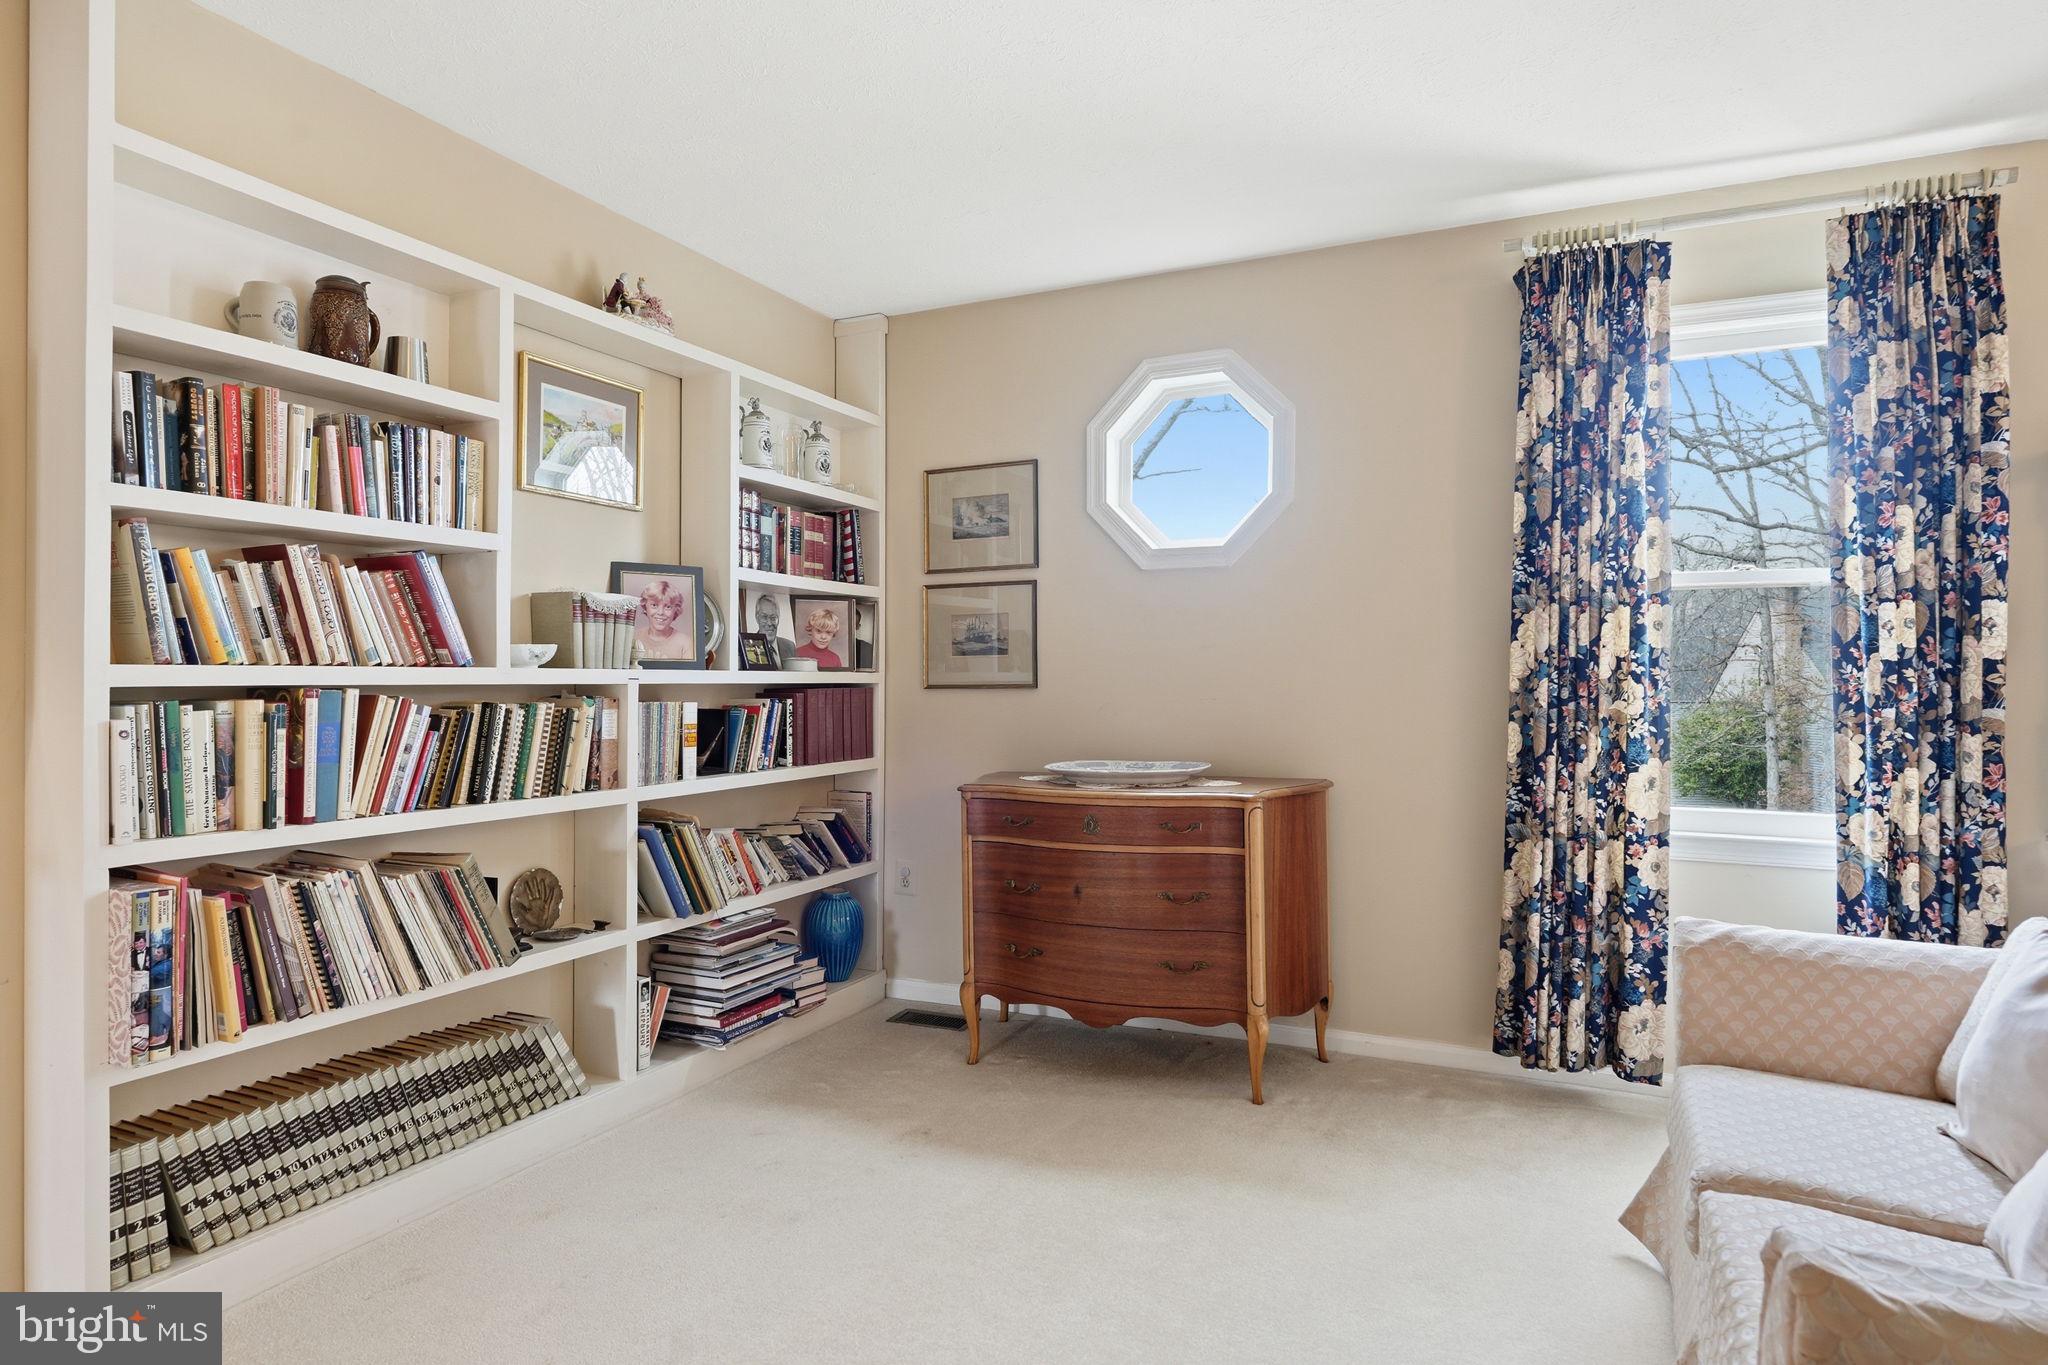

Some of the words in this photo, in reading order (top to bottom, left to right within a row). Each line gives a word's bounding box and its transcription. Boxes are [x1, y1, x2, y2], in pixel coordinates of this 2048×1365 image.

[140, 548, 156, 584] ZANE
[145, 580, 162, 619] GREY
[182, 727, 191, 751] BOOK
[144, 728, 153, 772] CROCKERY
[184, 755, 193, 794] SAUSAGE
[119, 764, 128, 805] CHOCOLATE
[147, 775, 155, 814] COOKING
[185, 799, 194, 818] THE
[430, 1109, 441, 1120] 20
[444, 1106, 455, 1117] 21
[404, 1120, 414, 1130] 18
[418, 1114, 428, 1125] 19
[391, 1124, 400, 1135] 17
[363, 1135, 374, 1146] 15
[377, 1130, 387, 1141] 16
[348, 1140, 359, 1152] 14
[319, 1151, 331, 1163] 12
[334, 1146, 345, 1158] 13
[288, 1161, 300, 1175] 10
[306, 1157, 315, 1168] 11
[274, 1169, 282, 1178] 9
[258, 1175, 266, 1184] 8
[241, 1181, 248, 1191] 7
[224, 1187, 232, 1197] 6
[206, 1194, 214, 1204] 5
[187, 1202, 196, 1212] 4
[153, 1213, 162, 1225] 3
[134, 1221, 143, 1232] 2
[114, 1229, 120, 1240] 1
